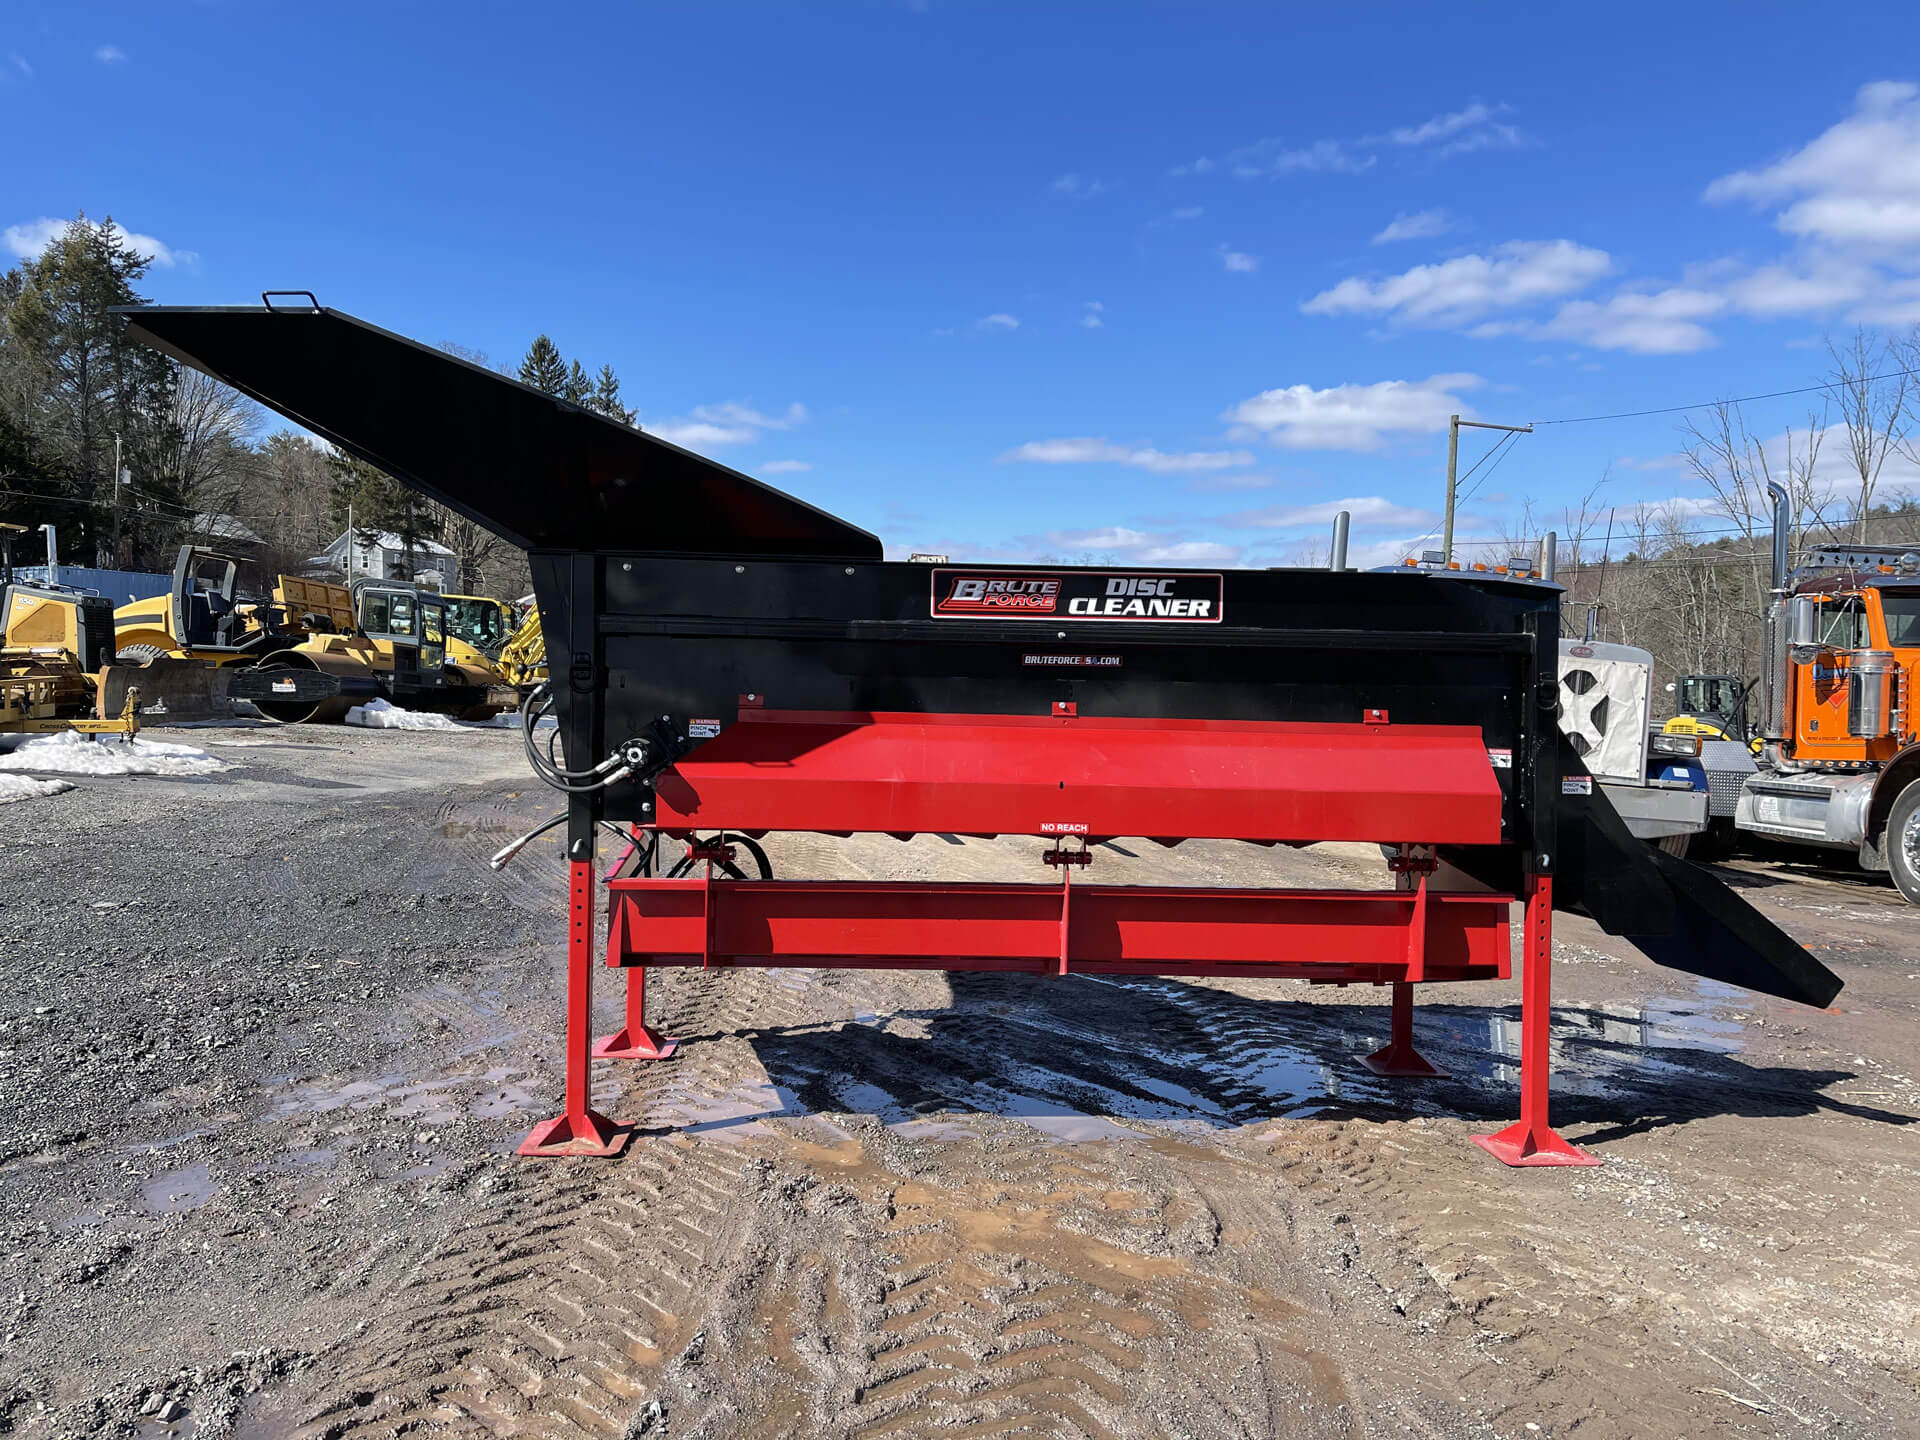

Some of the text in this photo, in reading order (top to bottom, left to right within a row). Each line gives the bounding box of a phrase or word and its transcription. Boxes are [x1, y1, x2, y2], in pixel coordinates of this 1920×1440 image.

[951, 579, 1059, 601] BRUTE
[1105, 578, 1177, 597] DISC
[982, 593, 1057, 607] FORCE
[1068, 597, 1211, 617] CLEANER
[1041, 823, 1088, 831] NO REACH
